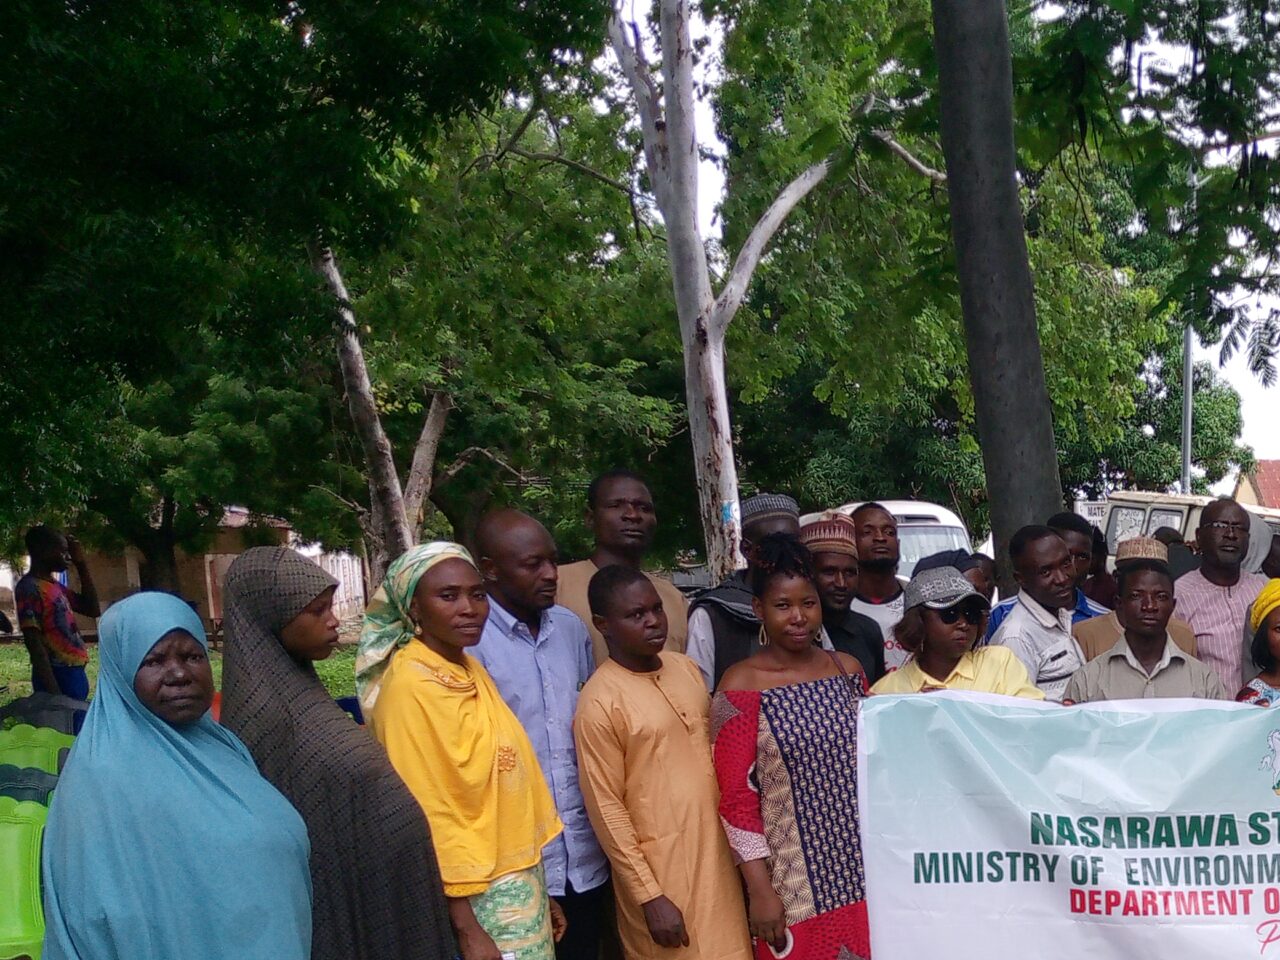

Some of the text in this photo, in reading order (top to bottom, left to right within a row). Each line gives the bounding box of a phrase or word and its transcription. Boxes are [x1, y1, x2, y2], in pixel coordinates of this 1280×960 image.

[1031, 811, 1239, 849] NASARAWA
[913, 851, 1060, 884] MINISTRY
[1071, 855, 1105, 886] OF
[1069, 887, 1253, 916] DEPARTMENT
